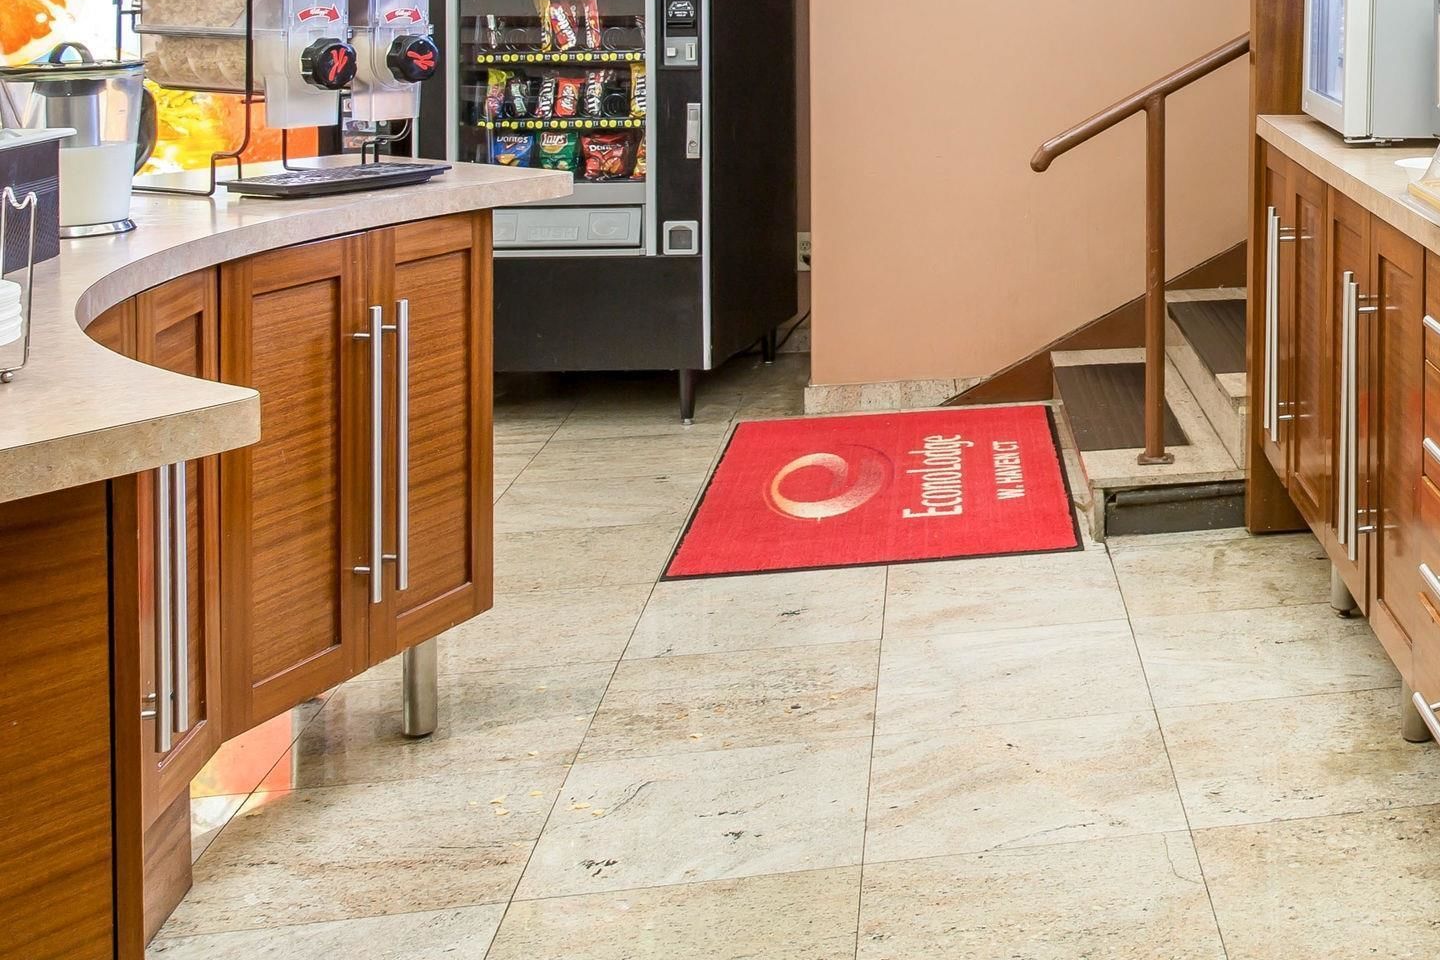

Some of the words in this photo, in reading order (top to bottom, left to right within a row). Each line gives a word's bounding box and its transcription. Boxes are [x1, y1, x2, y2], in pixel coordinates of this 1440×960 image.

[992, 440, 1020, 451] CT
[902, 434, 974, 518] EconoLodge
[993, 452, 1023, 484] HAVEN
[996, 484, 1025, 500] W.
